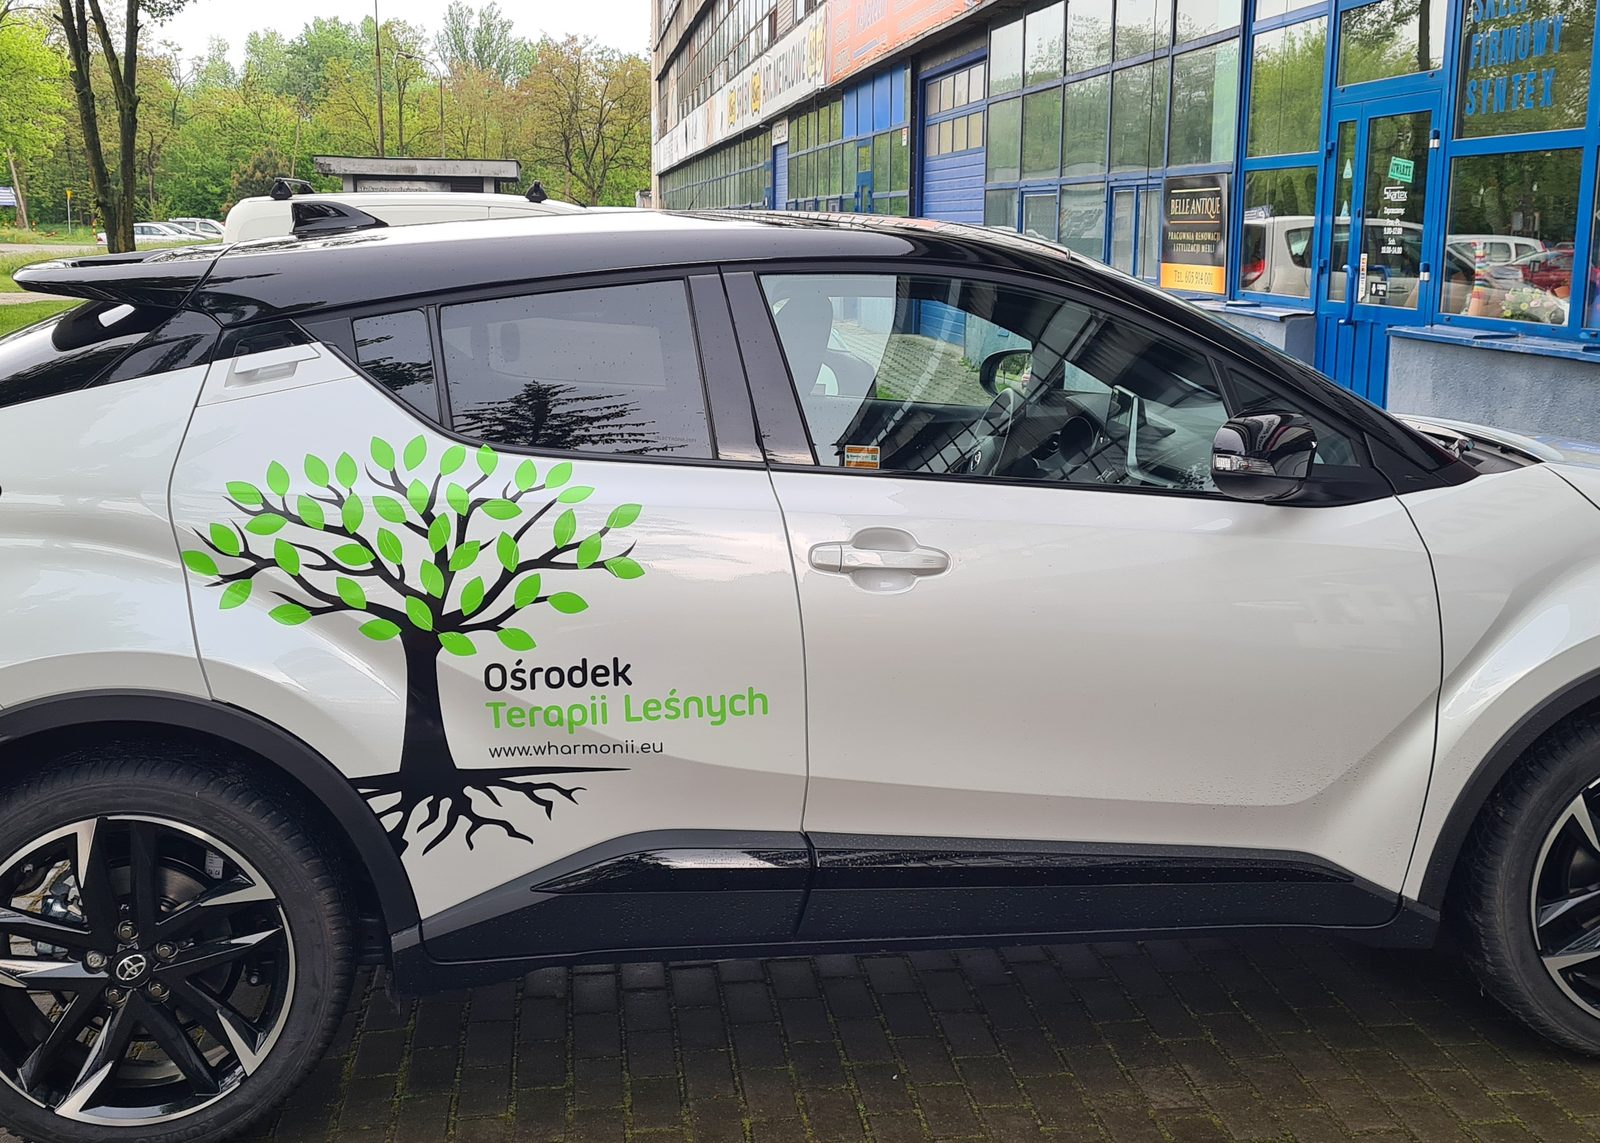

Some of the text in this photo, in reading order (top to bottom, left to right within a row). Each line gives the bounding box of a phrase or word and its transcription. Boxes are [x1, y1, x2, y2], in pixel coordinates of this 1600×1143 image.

[1469, 14, 1564, 70] FIRMOWY
[1465, 68, 1557, 117] SYNTEX
[1170, 197, 1221, 219] BELLE ANTIQUE
[484, 656, 633, 692] Ośrodek
[485, 687, 769, 735] Terapii Leśnych
[488, 739, 664, 759] www.wharmonii.eu
